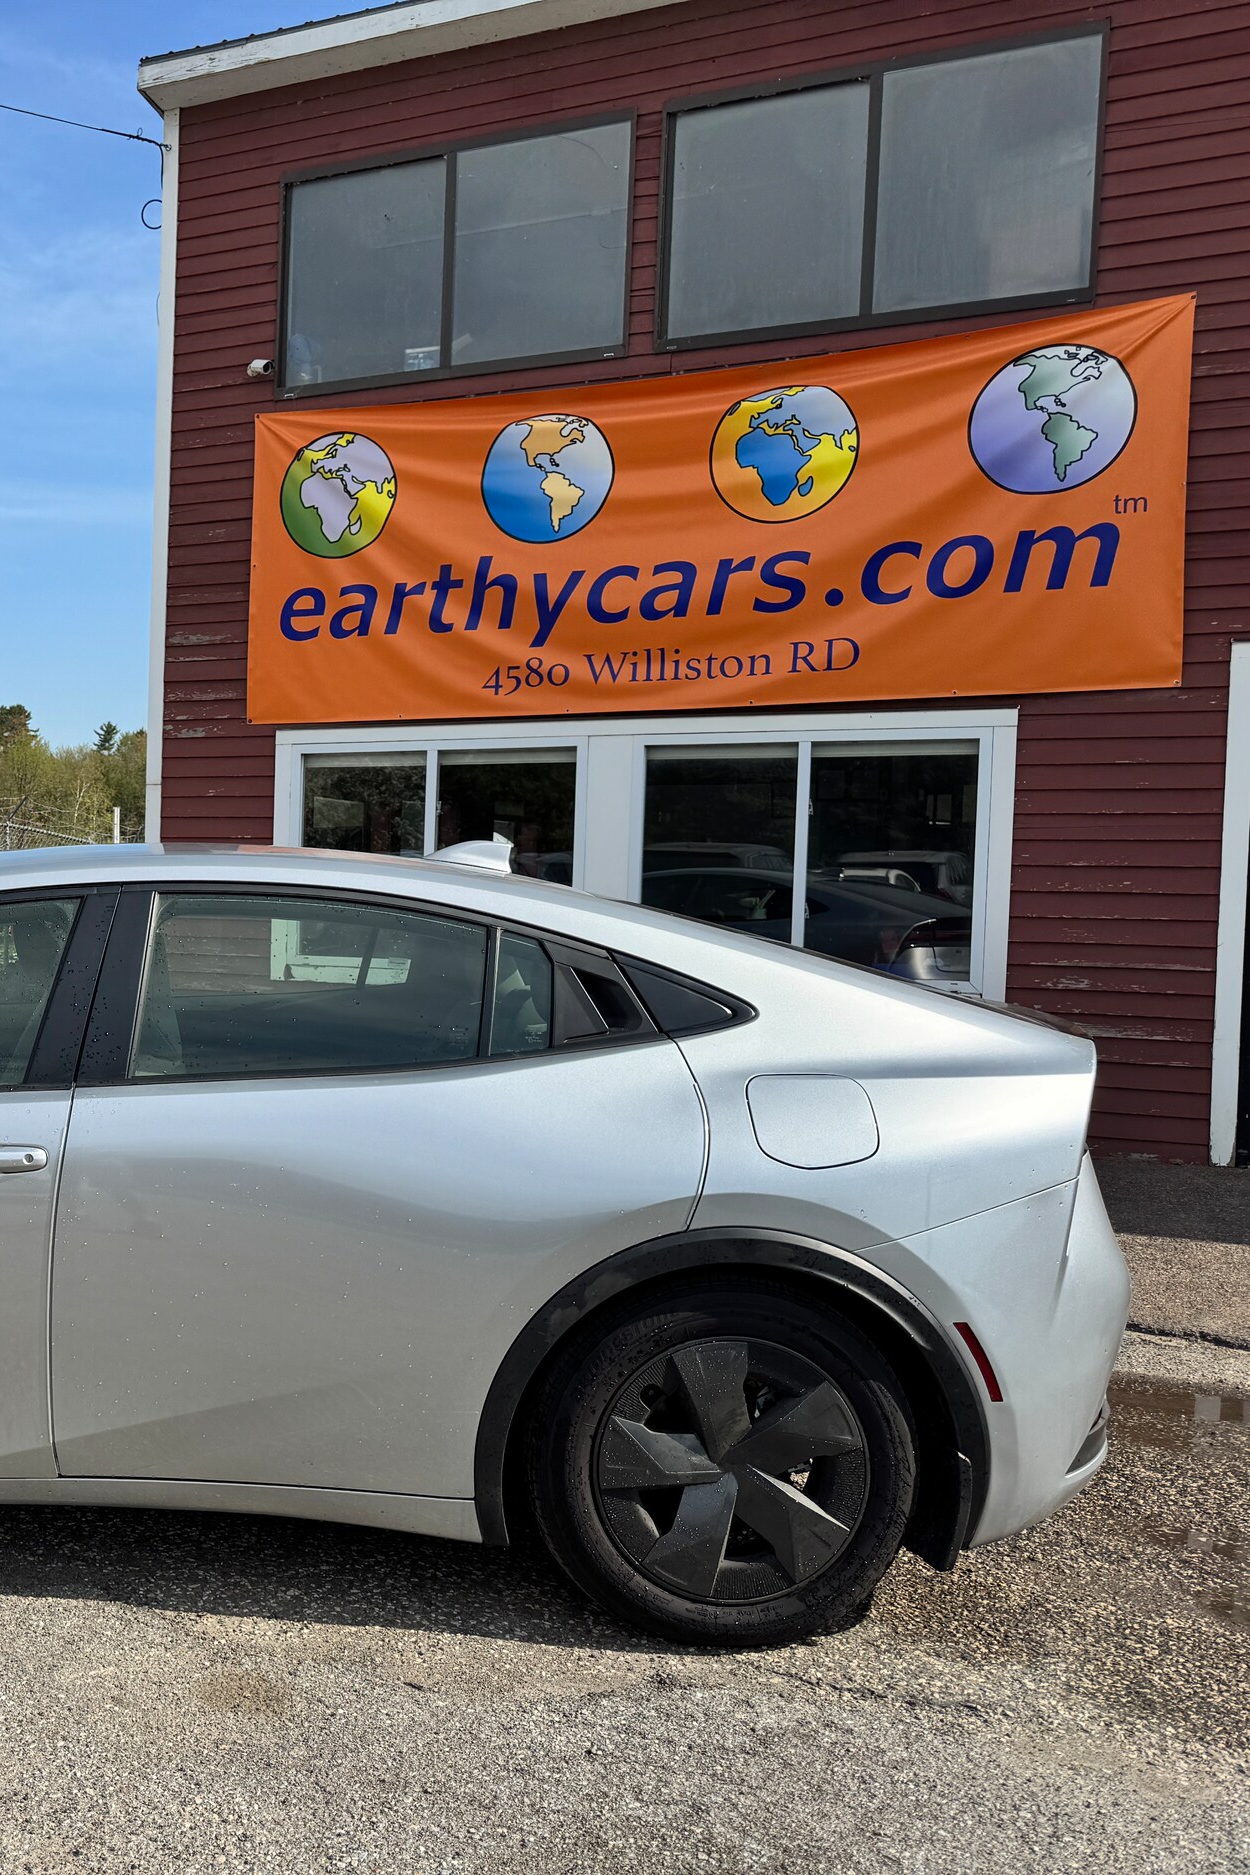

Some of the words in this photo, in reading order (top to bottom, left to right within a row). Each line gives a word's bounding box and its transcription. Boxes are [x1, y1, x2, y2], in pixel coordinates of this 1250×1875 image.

[1113, 494, 1148, 514] tm
[278, 521, 1121, 648] earthycars.com
[481, 656, 570, 696] 4580
[583, 647, 772, 684] Williston
[787, 637, 861, 673] RD
